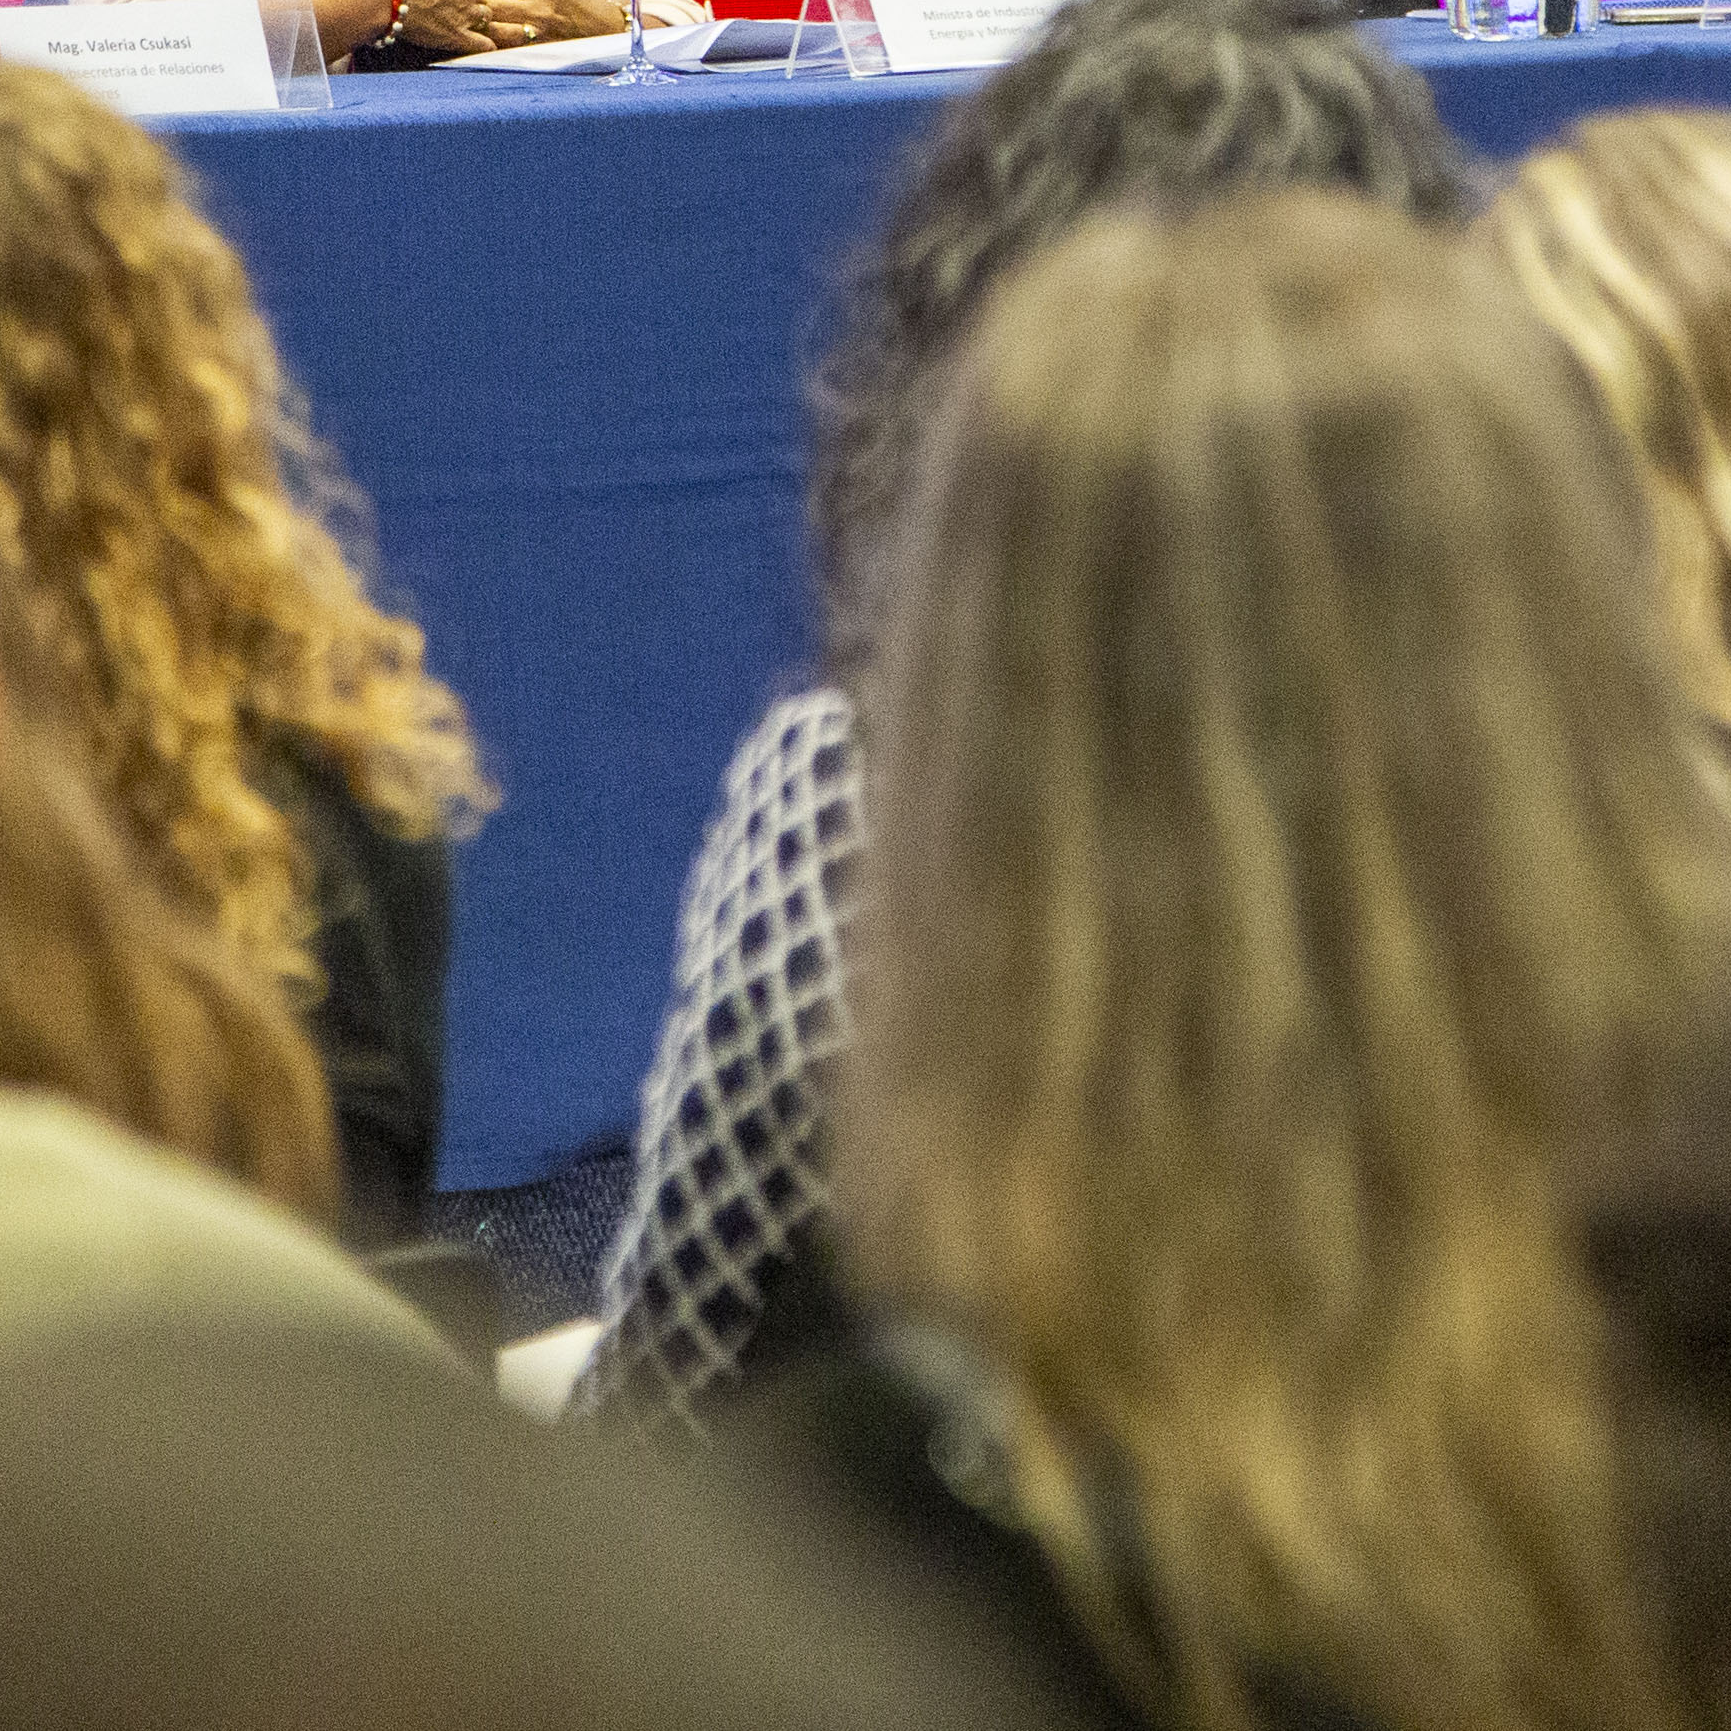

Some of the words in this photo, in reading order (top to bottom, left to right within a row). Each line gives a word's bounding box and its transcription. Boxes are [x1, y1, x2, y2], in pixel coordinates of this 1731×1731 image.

[922, 9, 974, 22] Ministra
[976, 7, 991, 19] de
[48, 40, 84, 56] Mag.
[86, 38, 137, 54] Valeria
[139, 35, 192, 52] Csukasi
[140, 63, 156, 77] de
[159, 61, 226, 76] Relaciones
